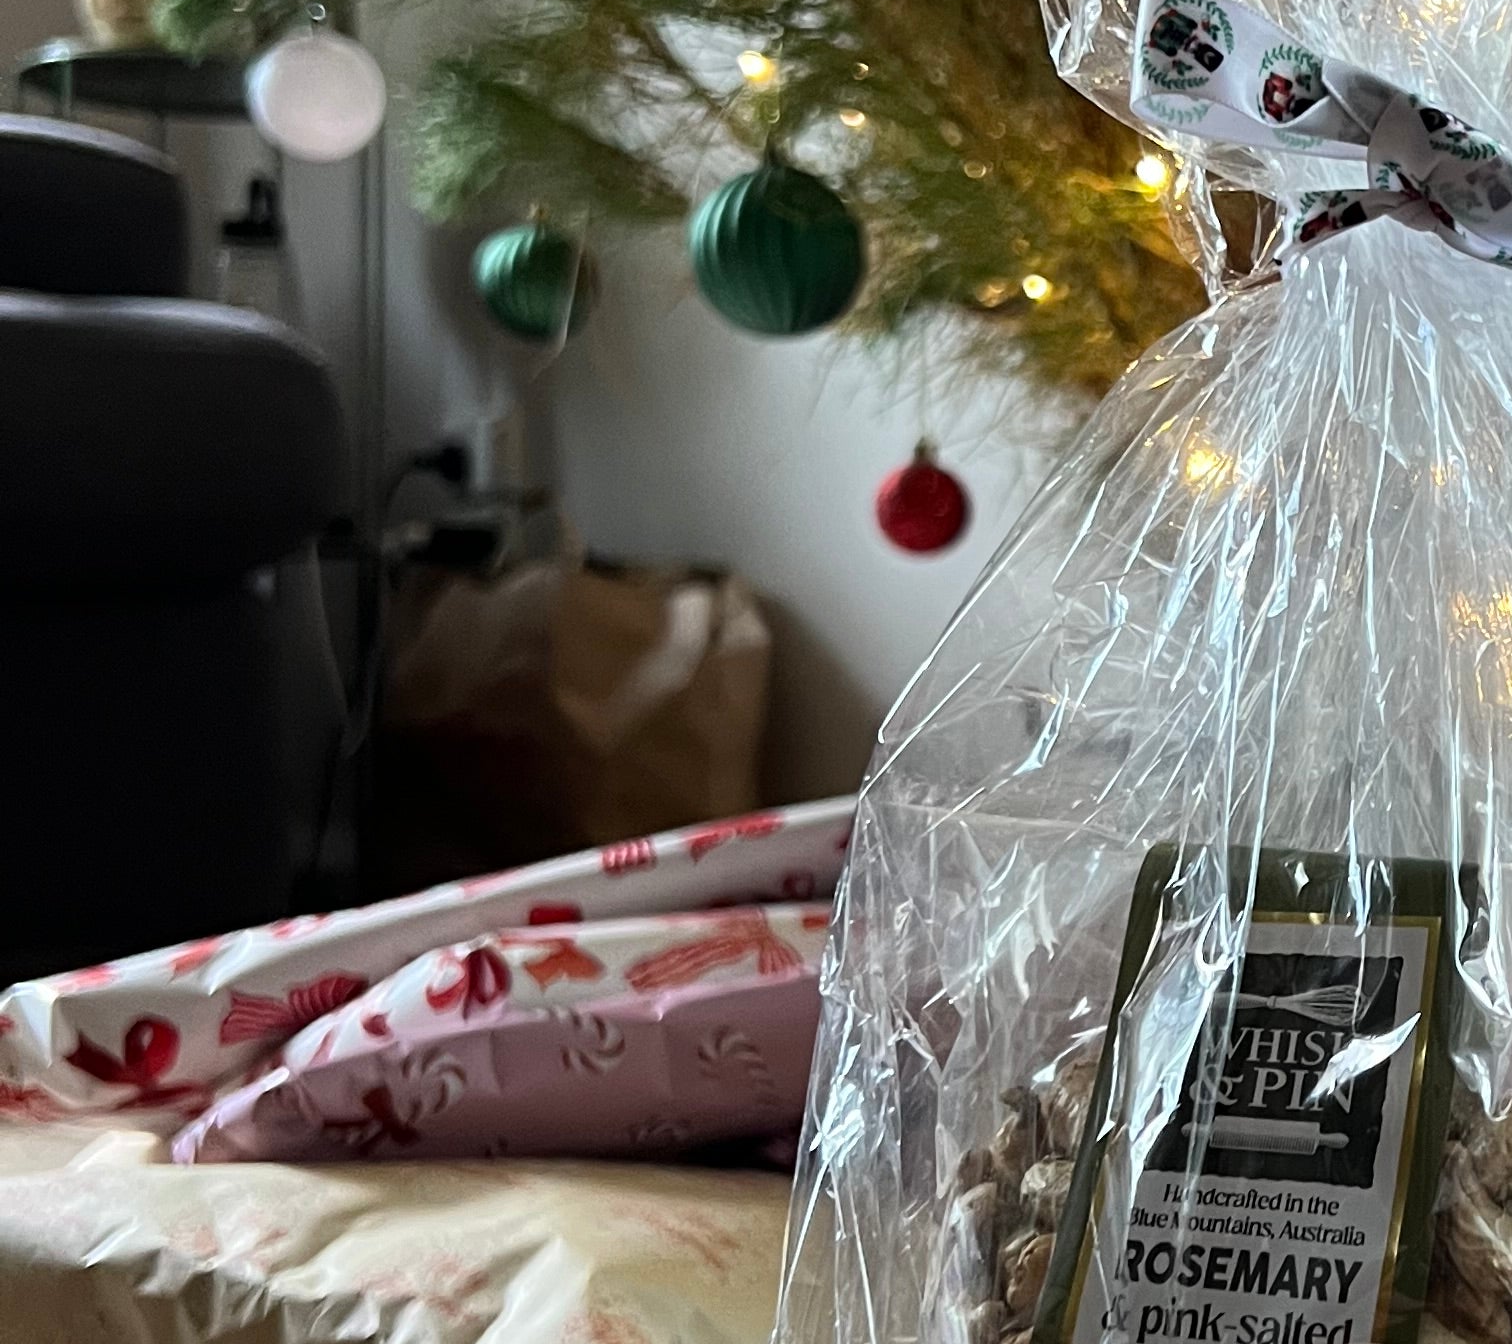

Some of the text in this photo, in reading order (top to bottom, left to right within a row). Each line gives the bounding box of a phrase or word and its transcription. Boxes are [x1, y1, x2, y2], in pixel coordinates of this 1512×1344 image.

[1189, 1064, 1356, 1114] & PIN
[1284, 1191, 1303, 1211] in
[1307, 1195, 1340, 1216] the
[1129, 1207, 1169, 1229] Blue
[1279, 1224, 1366, 1247] Australia
[1115, 1240, 1363, 1305] ROSEMARY
[1102, 1293, 1131, 1332] &
